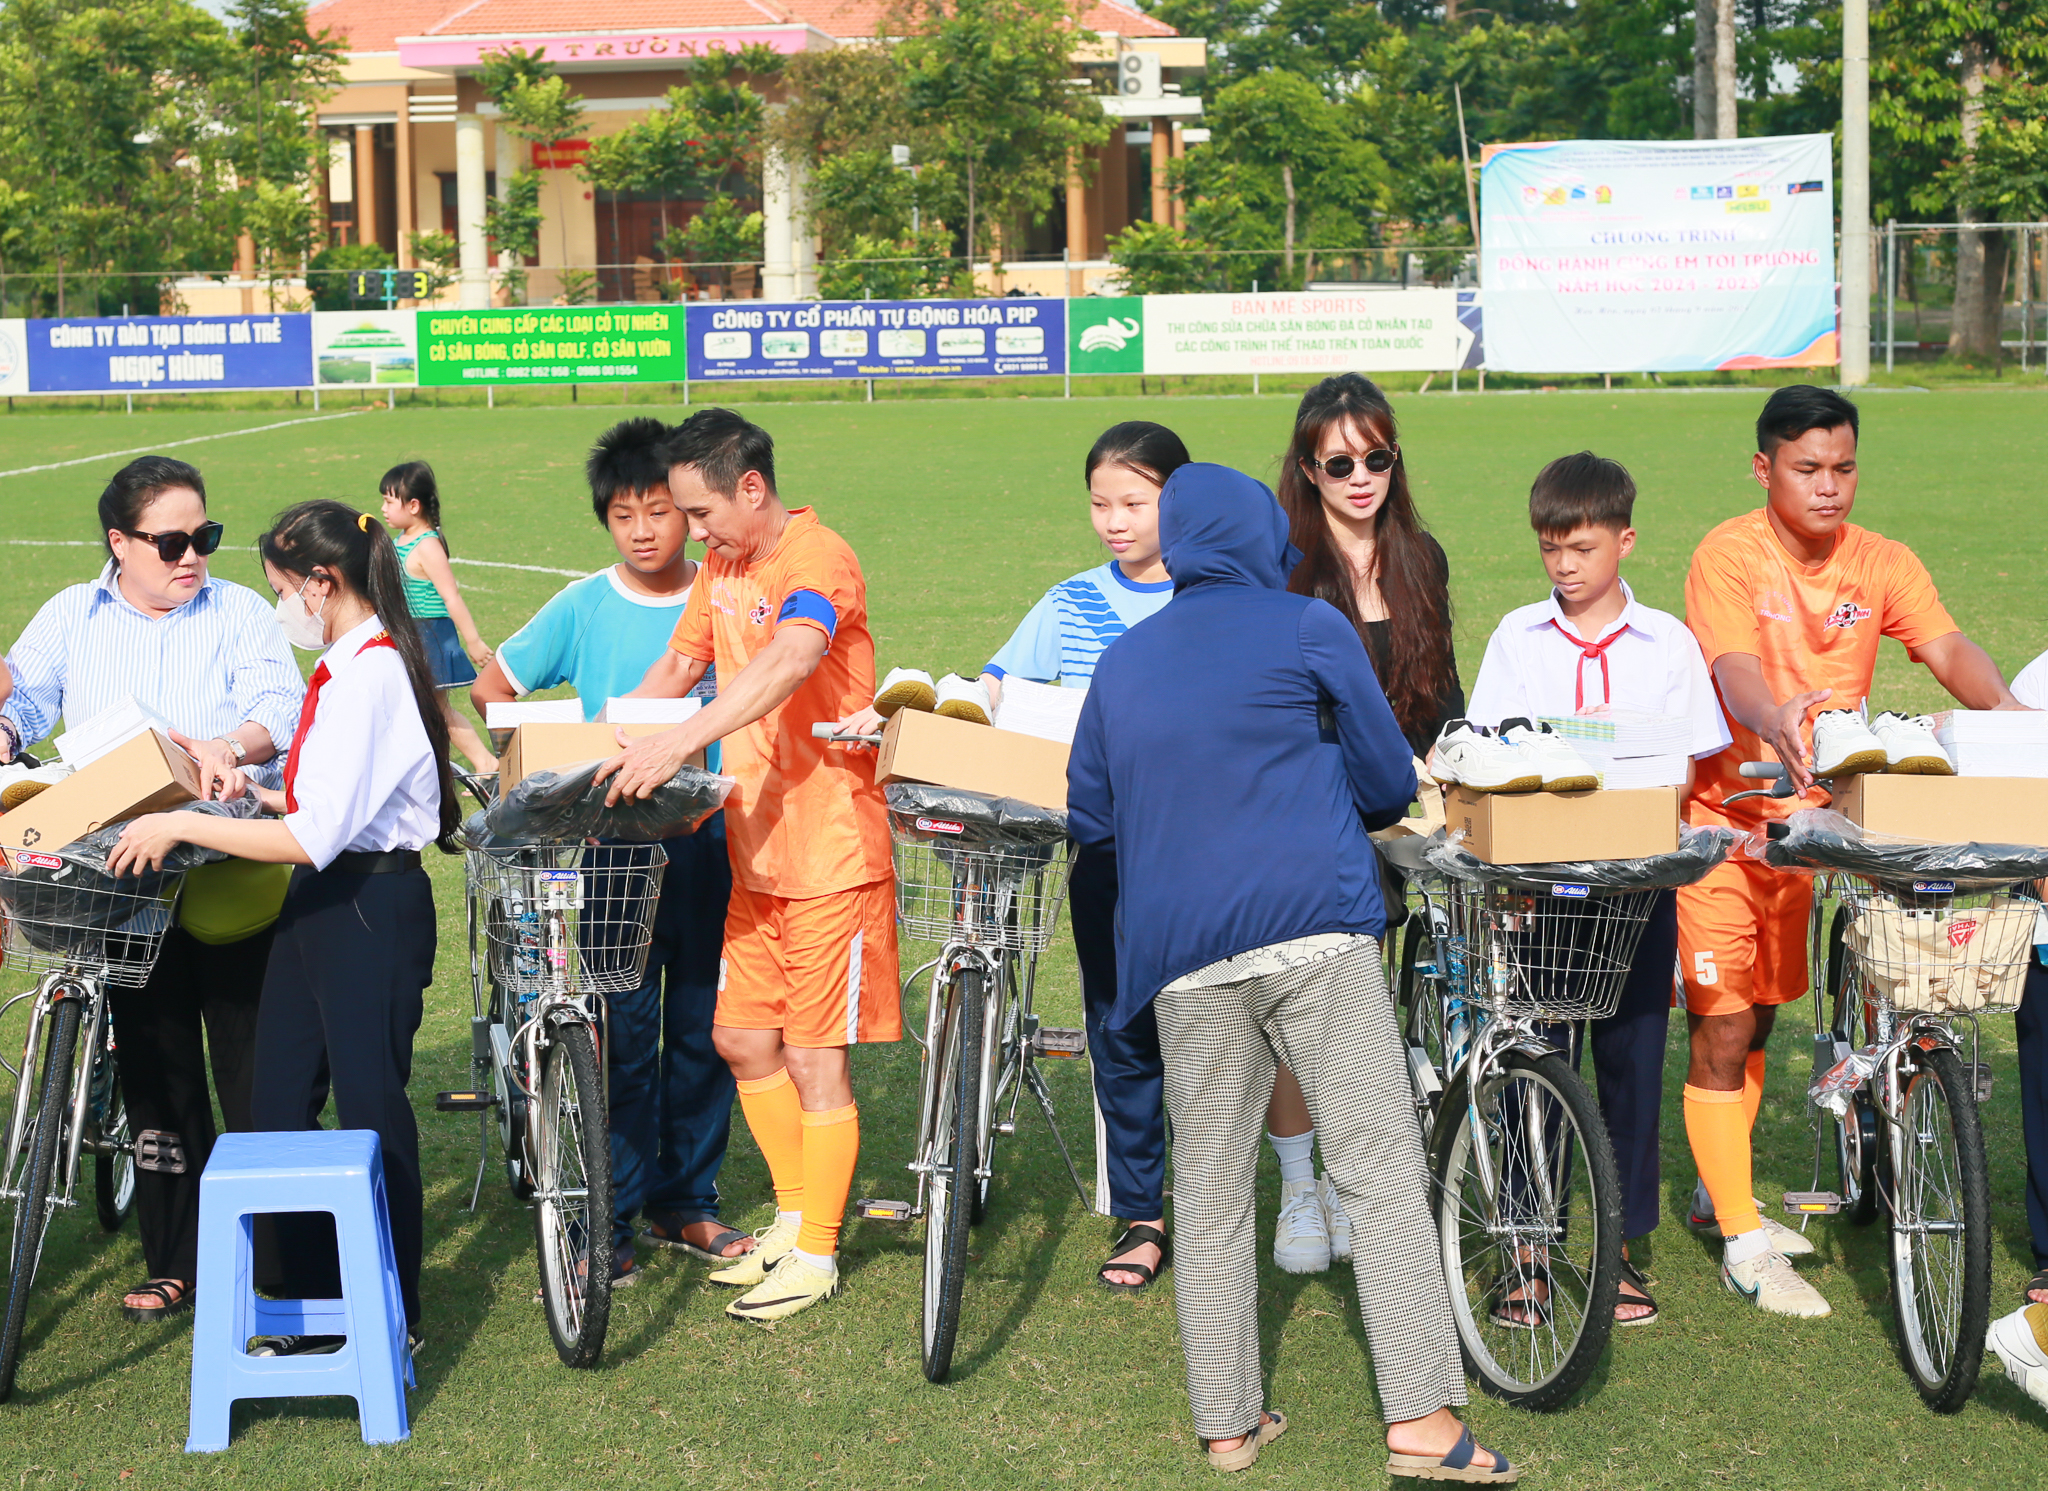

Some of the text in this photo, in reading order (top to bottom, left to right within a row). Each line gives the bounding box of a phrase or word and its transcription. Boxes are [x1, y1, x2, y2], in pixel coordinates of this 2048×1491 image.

[1675, 256, 1698, 268] EM
[1651, 278, 1696, 292] 2024
[1716, 277, 1760, 290] 2025
[1301, 298, 1367, 314] SPORTS
[430, 311, 669, 335] CHUYÊN CUNG CẤP CÁC LOẠI CỎ TỰ NHIÊN
[712, 304, 1038, 329] CÔNG TY CỔ PHẦN TỰ ĐỘNG HÓA PIP
[50, 316, 282, 350] CÔNG TY ĐÀO TẠO BÓNG ĐÁ TRẺ
[1167, 322, 1185, 333] THI
[1188, 320, 1218, 333] CÔNG
[1306, 318, 1336, 332] BÓNG
[429, 340, 446, 361] CỎ
[448, 341, 472, 361] SÂN
[512, 338, 529, 359] CỎ
[530, 340, 556, 359] SÂN
[593, 337, 610, 358] CỎ
[611, 338, 636, 358] SÂN
[1175, 340, 1197, 352] CÁC
[1200, 338, 1230, 352] CÔNG
[1296, 339, 1326, 350] THAO
[109, 350, 224, 388] NGỌC HÙNG
[933, 821, 960, 830] Attila
[31, 857, 59, 866] Attila
[1927, 882, 1953, 890] Attila
[1694, 951, 1718, 985] 5
